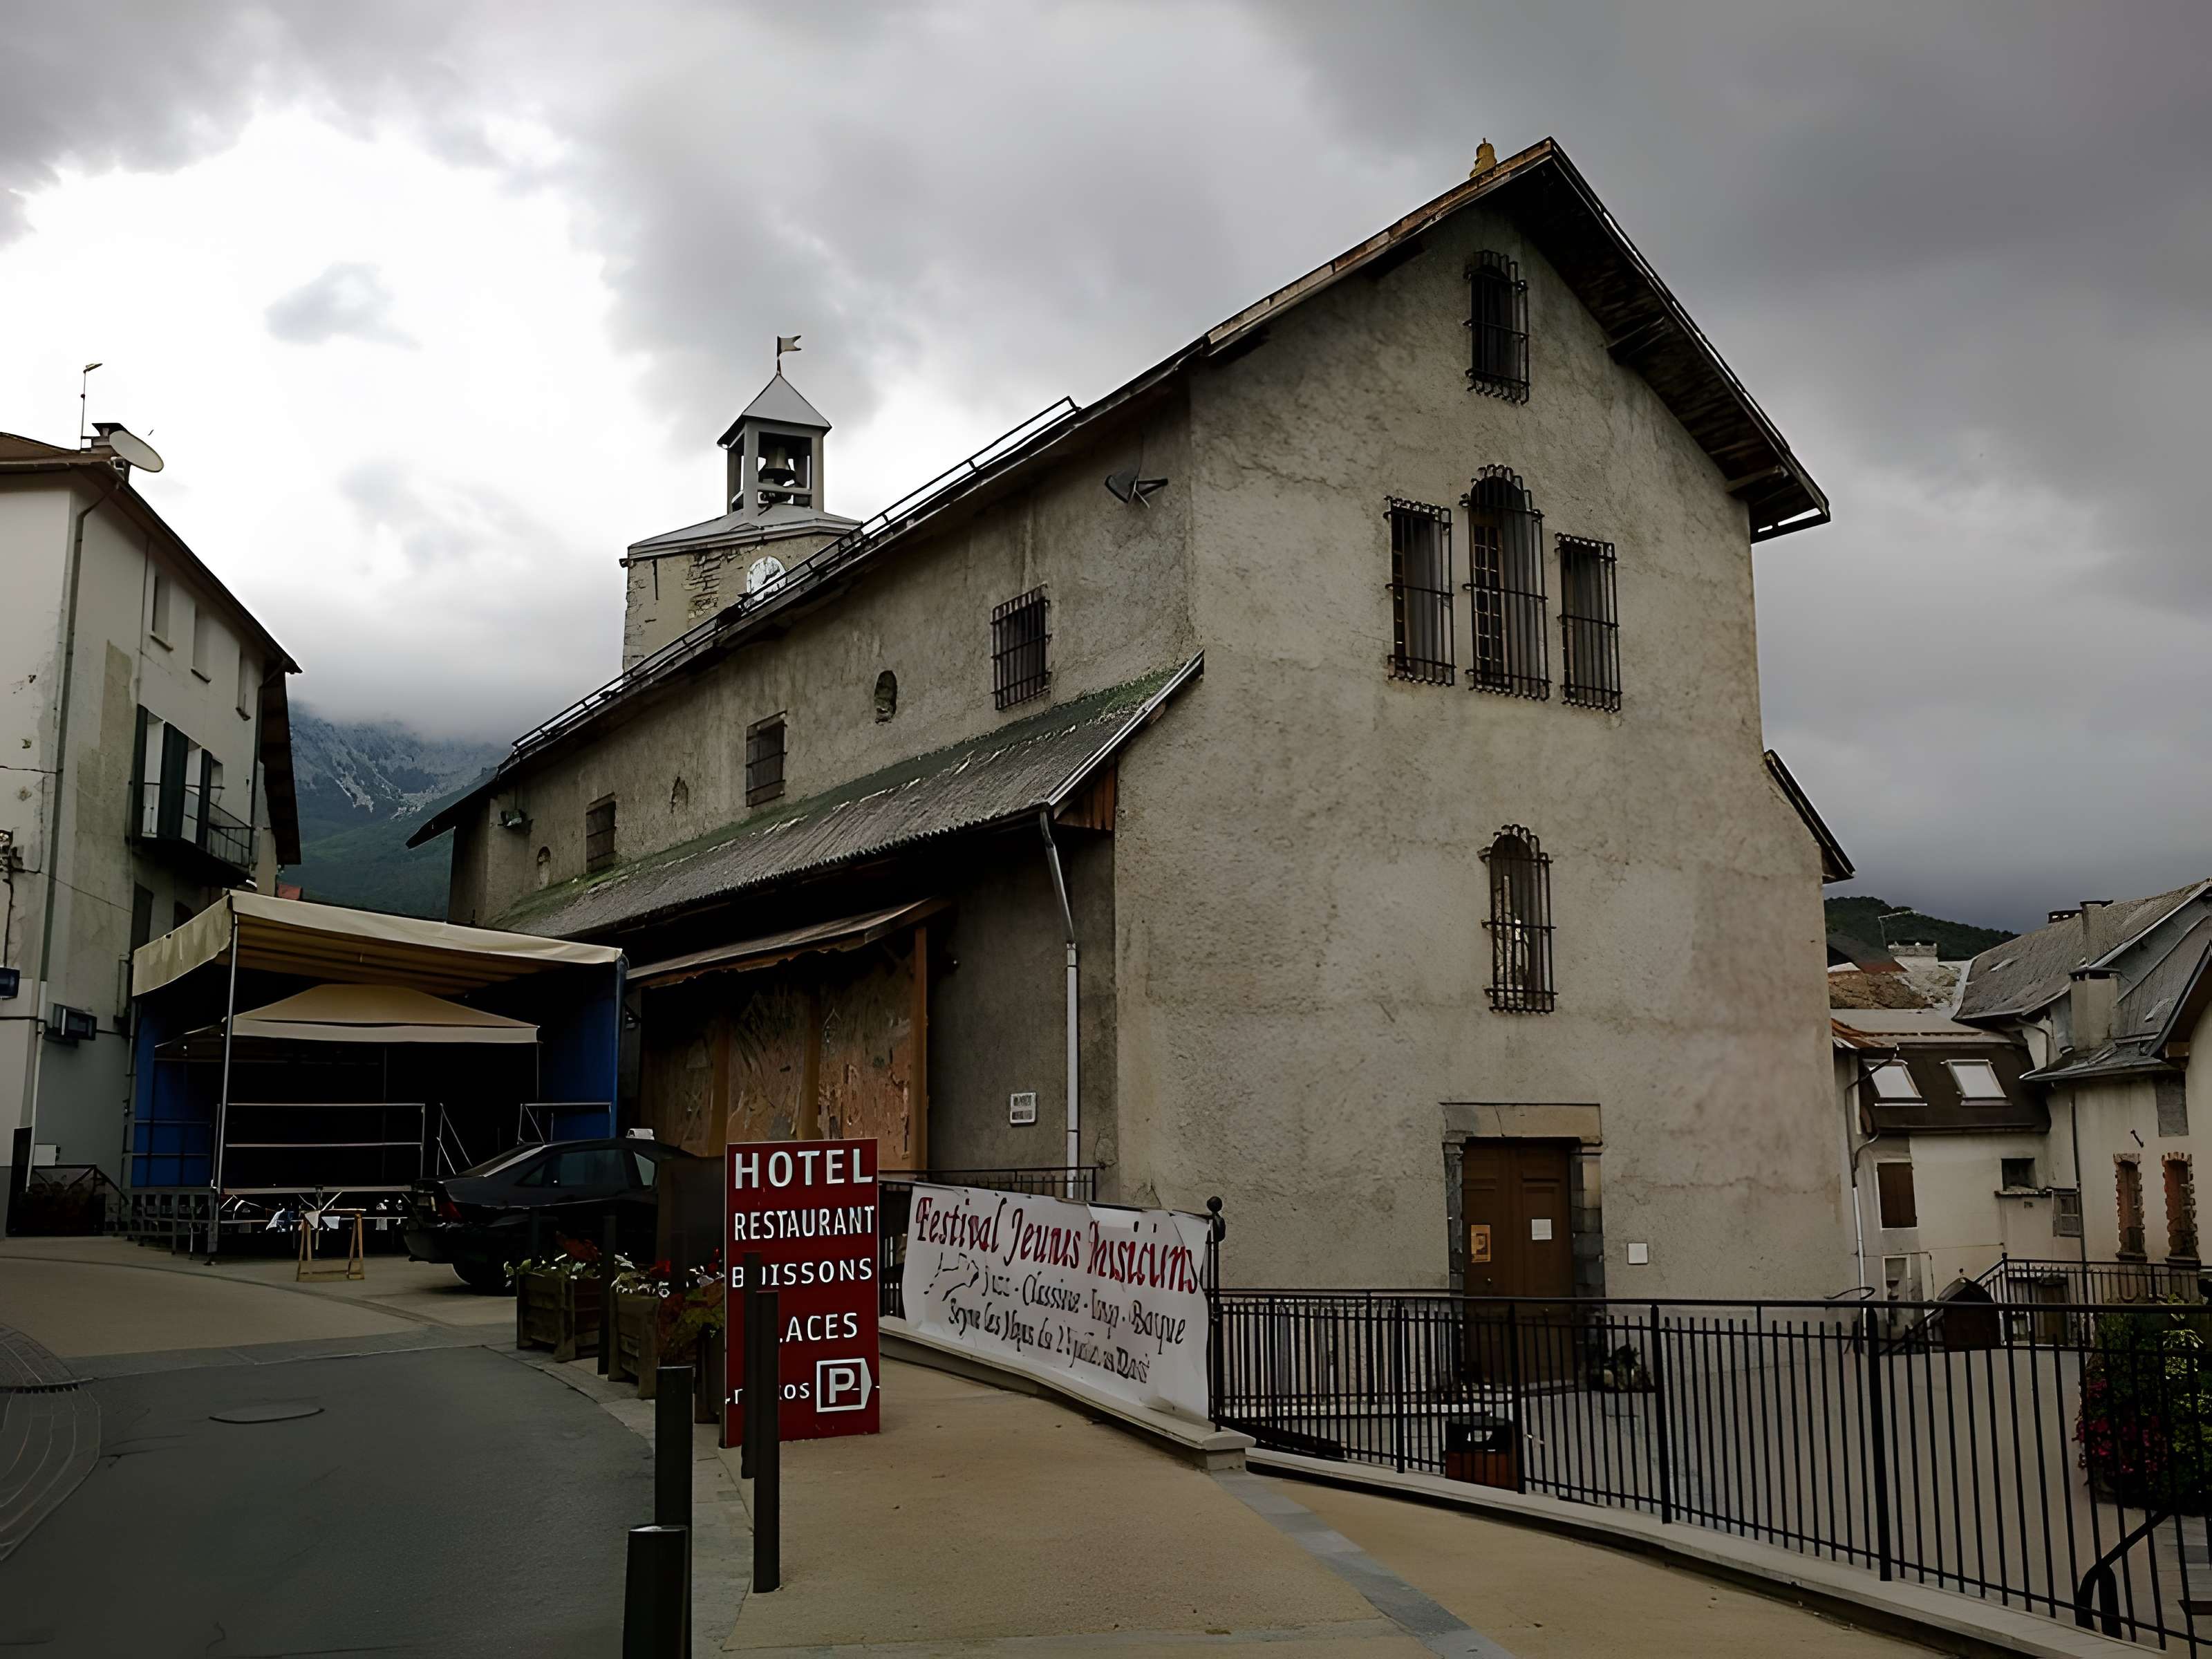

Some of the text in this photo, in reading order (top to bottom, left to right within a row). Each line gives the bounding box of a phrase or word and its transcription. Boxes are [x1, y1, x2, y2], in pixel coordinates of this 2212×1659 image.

[735, 1148, 873, 1189] HOTEL
[735, 1206, 874, 1241] RESTAURANT
[915, 1197, 1007, 1253] Festival
[732, 1257, 872, 1288] BISSONS
[780, 1313, 858, 1342] ACES
[829, 1367, 855, 1404] P
